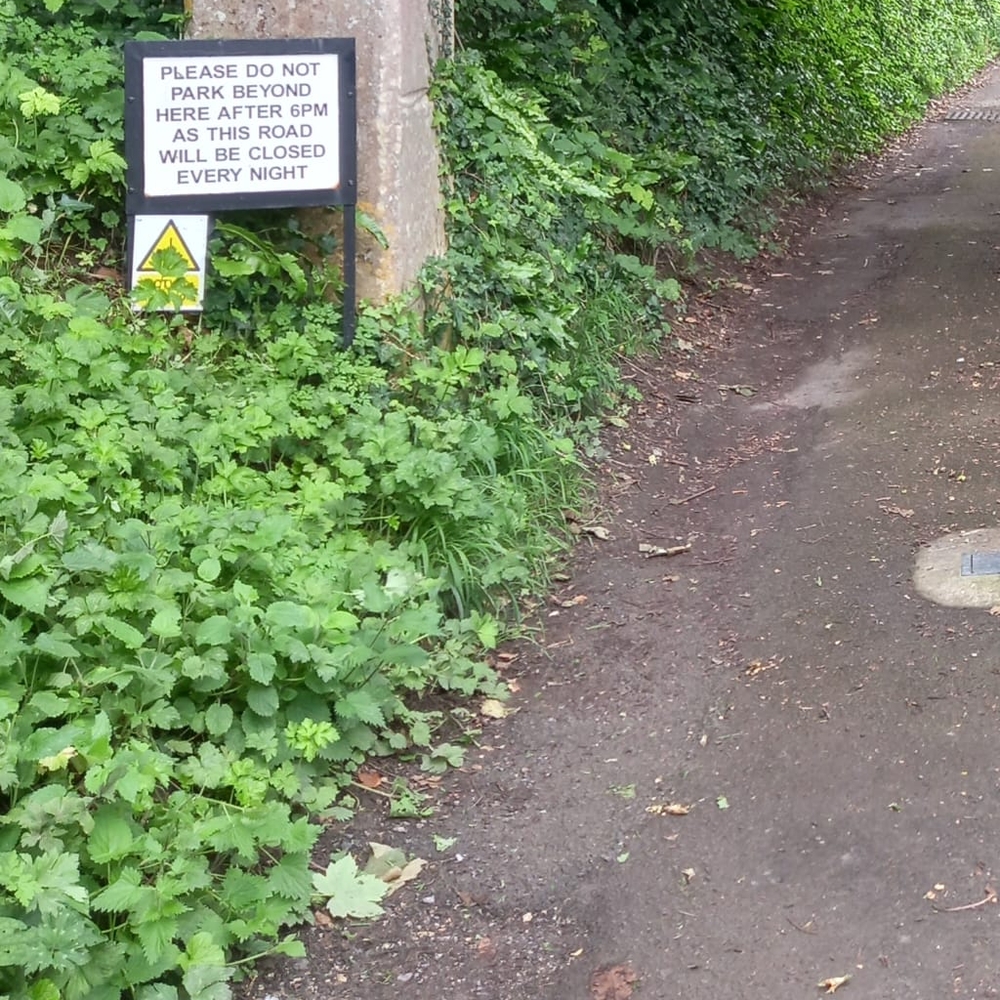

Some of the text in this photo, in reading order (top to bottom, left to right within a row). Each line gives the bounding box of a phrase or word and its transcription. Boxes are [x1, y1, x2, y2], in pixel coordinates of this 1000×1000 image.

[161, 62, 321, 80] PLEASE DO NOT
[171, 83, 312, 101] PARK BEYOND
[156, 103, 328, 122] HERE AFTER 6PM
[172, 124, 313, 143] AS THIS ROAD
[158, 144, 326, 164] WILL BE CLOSED
[177, 165, 308, 185] EVERY NIGHT
